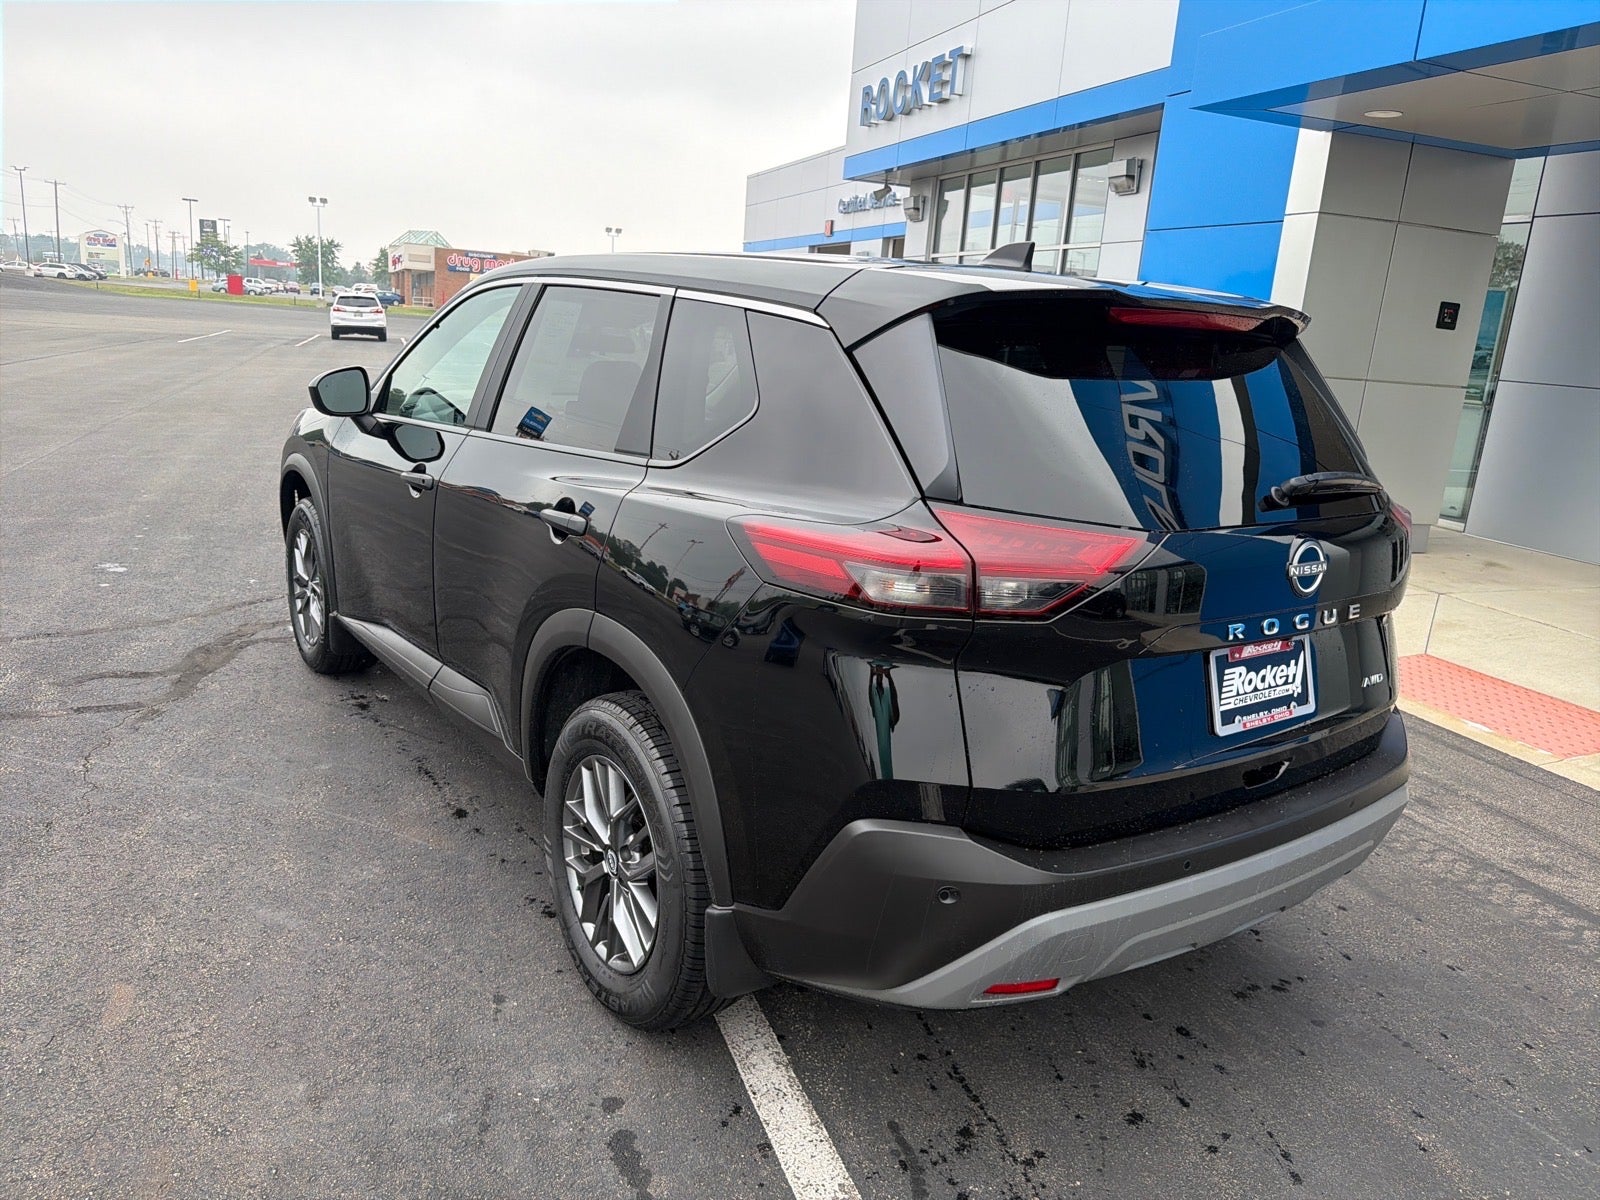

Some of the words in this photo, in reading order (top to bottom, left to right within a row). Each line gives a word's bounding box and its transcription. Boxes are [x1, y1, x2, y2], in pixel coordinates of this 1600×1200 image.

[860, 45, 970, 128] ROCKET
[447, 253, 480, 272] drug
[1290, 561, 1327, 577] NISSAN
[1228, 604, 1360, 640] ROGUE
[1222, 659, 1297, 697] Rocket
[1361, 673, 1384, 688] AWD
[1233, 688, 1290, 706] CHEVROLET.COM
[1274, 711, 1290, 721] OHIO
